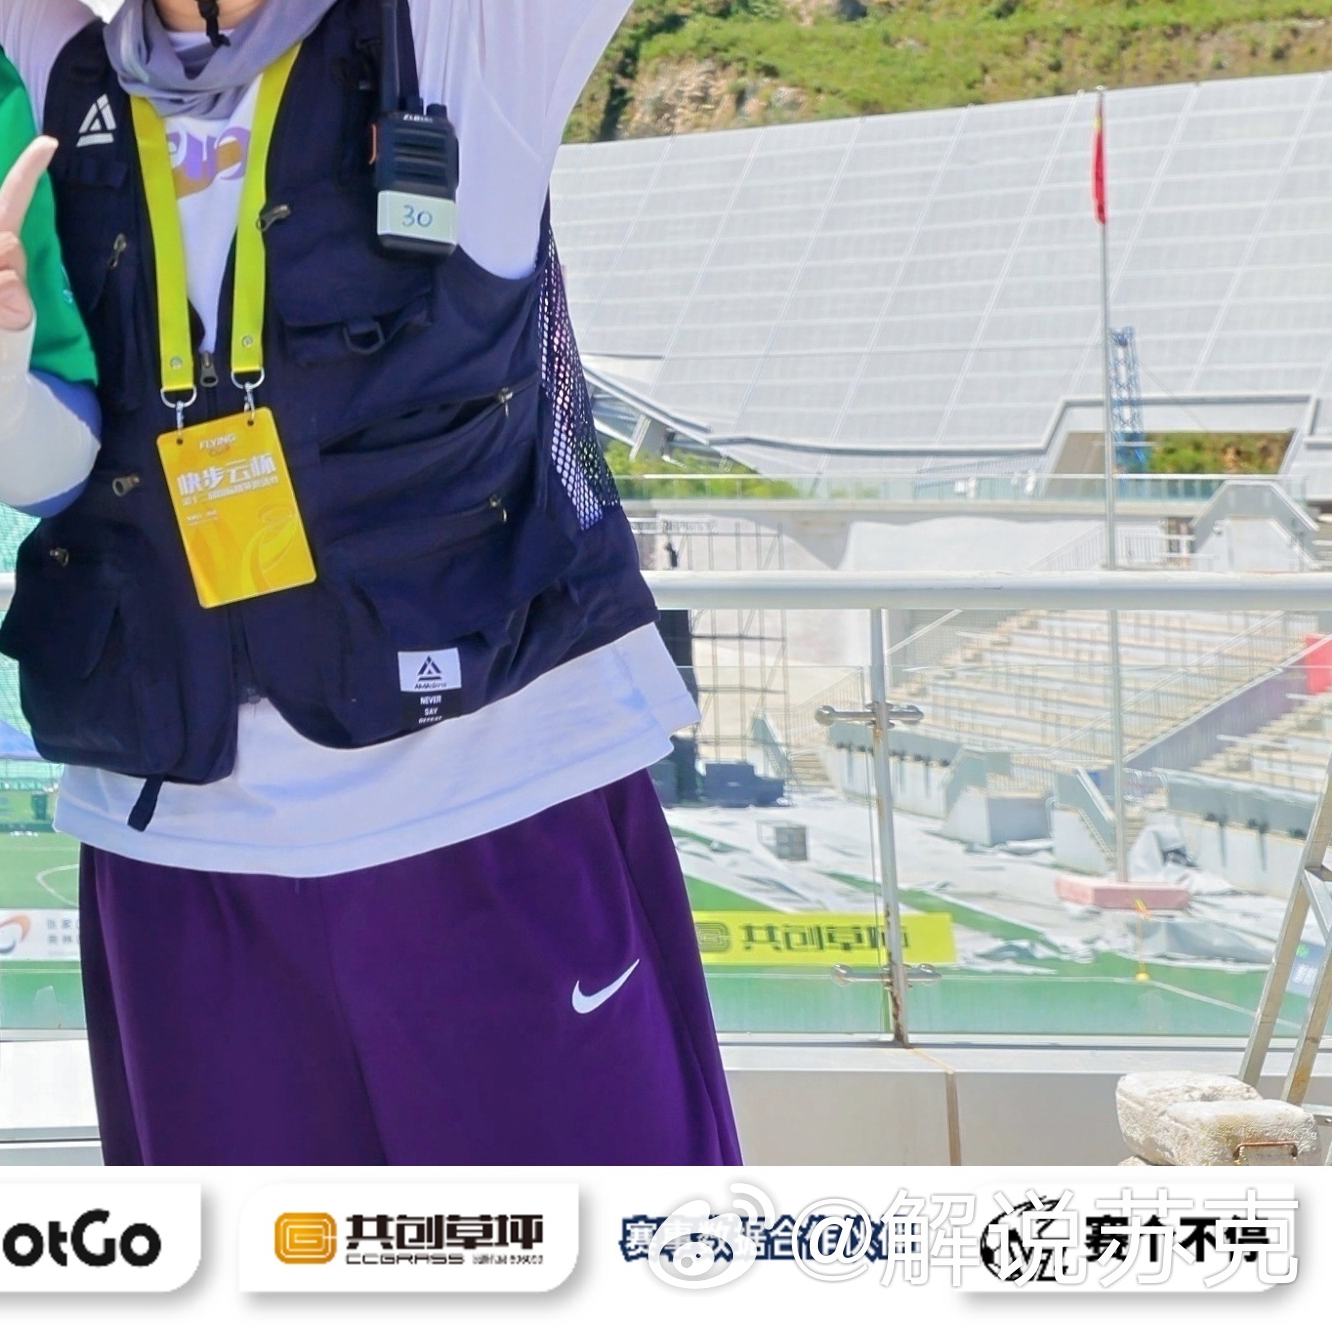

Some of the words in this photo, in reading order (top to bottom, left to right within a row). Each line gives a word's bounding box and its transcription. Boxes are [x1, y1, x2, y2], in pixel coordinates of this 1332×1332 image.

[402, 204, 433, 228] 30
[177, 452, 277, 496] 快步云杯
[420, 695, 442, 705] NEVER
[424, 707, 438, 716] SAY
